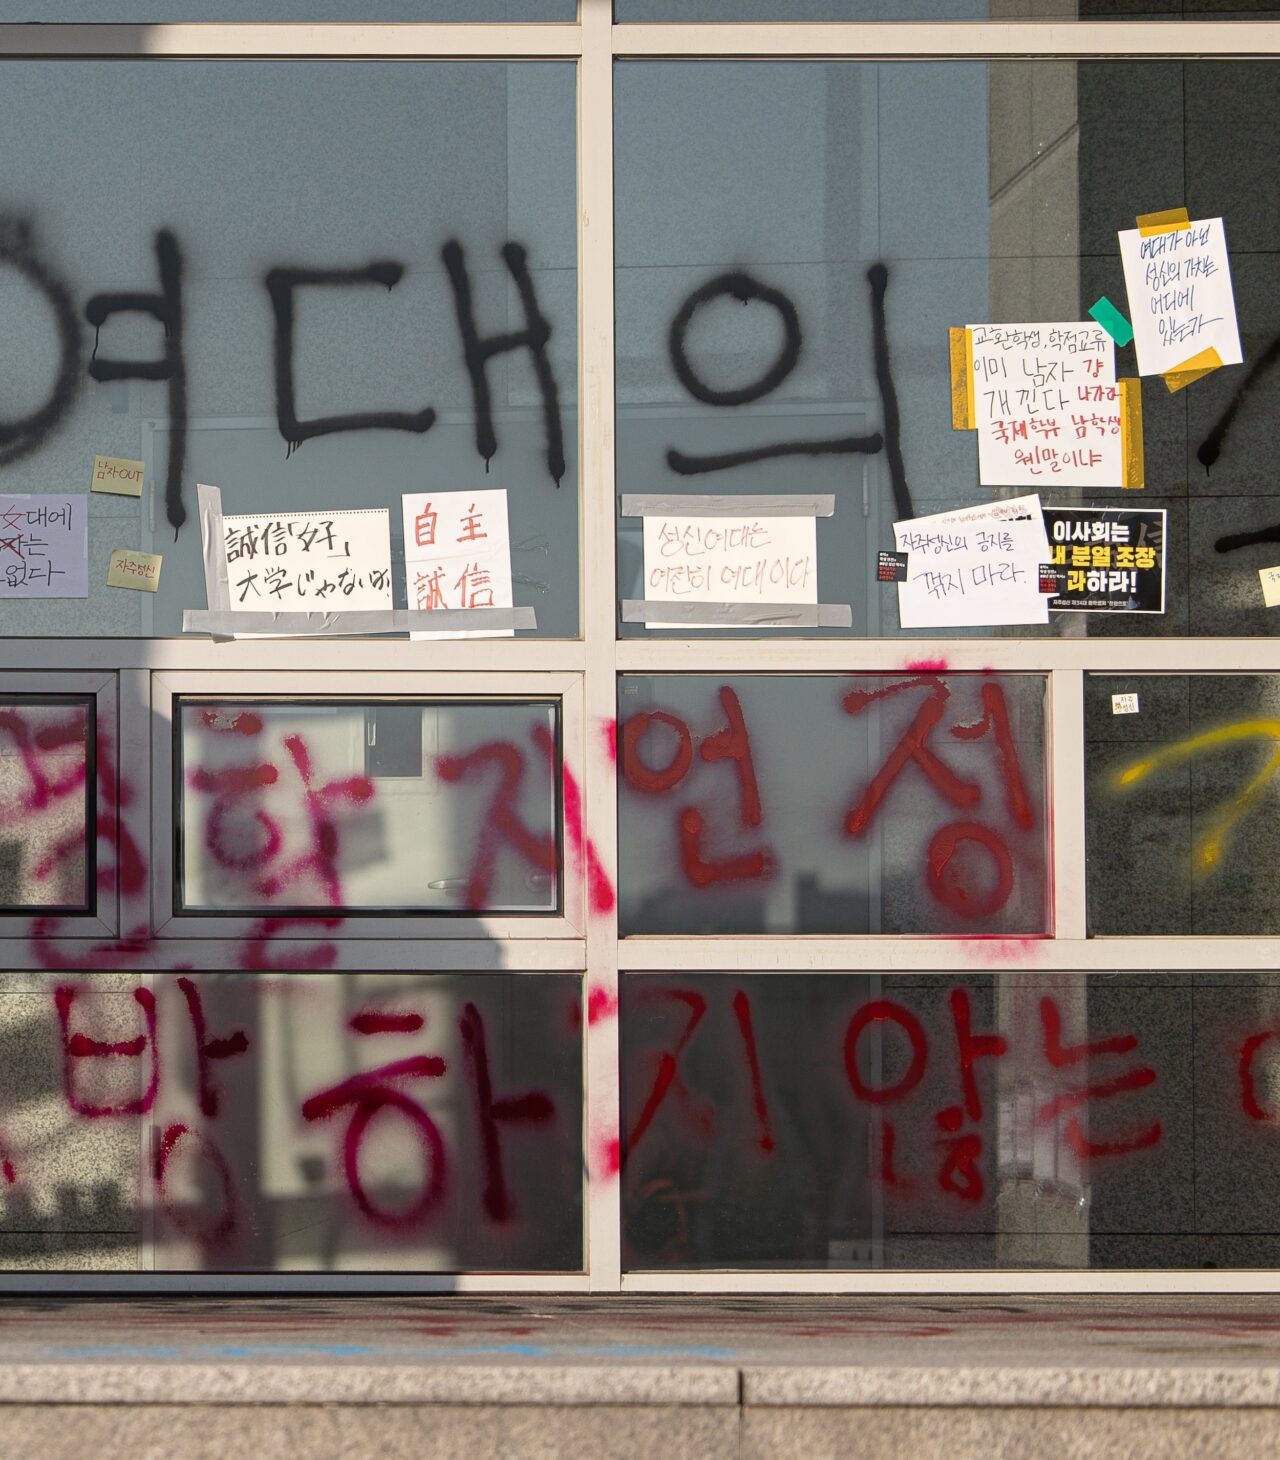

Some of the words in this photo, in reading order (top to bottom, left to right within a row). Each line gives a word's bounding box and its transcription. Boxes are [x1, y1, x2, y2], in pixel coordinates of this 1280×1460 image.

[1146, 259, 1181, 291] 성신의
[1151, 285, 1195, 315] 어디에
[1158, 314, 1225, 347] 있는가
[974, 356, 1007, 382] 이미
[1022, 357, 1074, 387] 남자
[1078, 385, 1123, 401] 나가라
[992, 418, 1061, 444] 국제학부
[1071, 413, 1122, 439] 남학생
[415, 502, 488, 547] 自主
[658, 522, 772, 556] 성신여대는
[1053, 520, 1129, 543] 이사회는
[900, 532, 968, 554] 자주성신의
[976, 531, 1014, 552] 긍지를
[1072, 545, 1111, 567] 분열
[1116, 546, 1156, 568] 조장
[414, 562, 495, 611] 誠信
[1067, 570, 1137, 593] 과하라!
